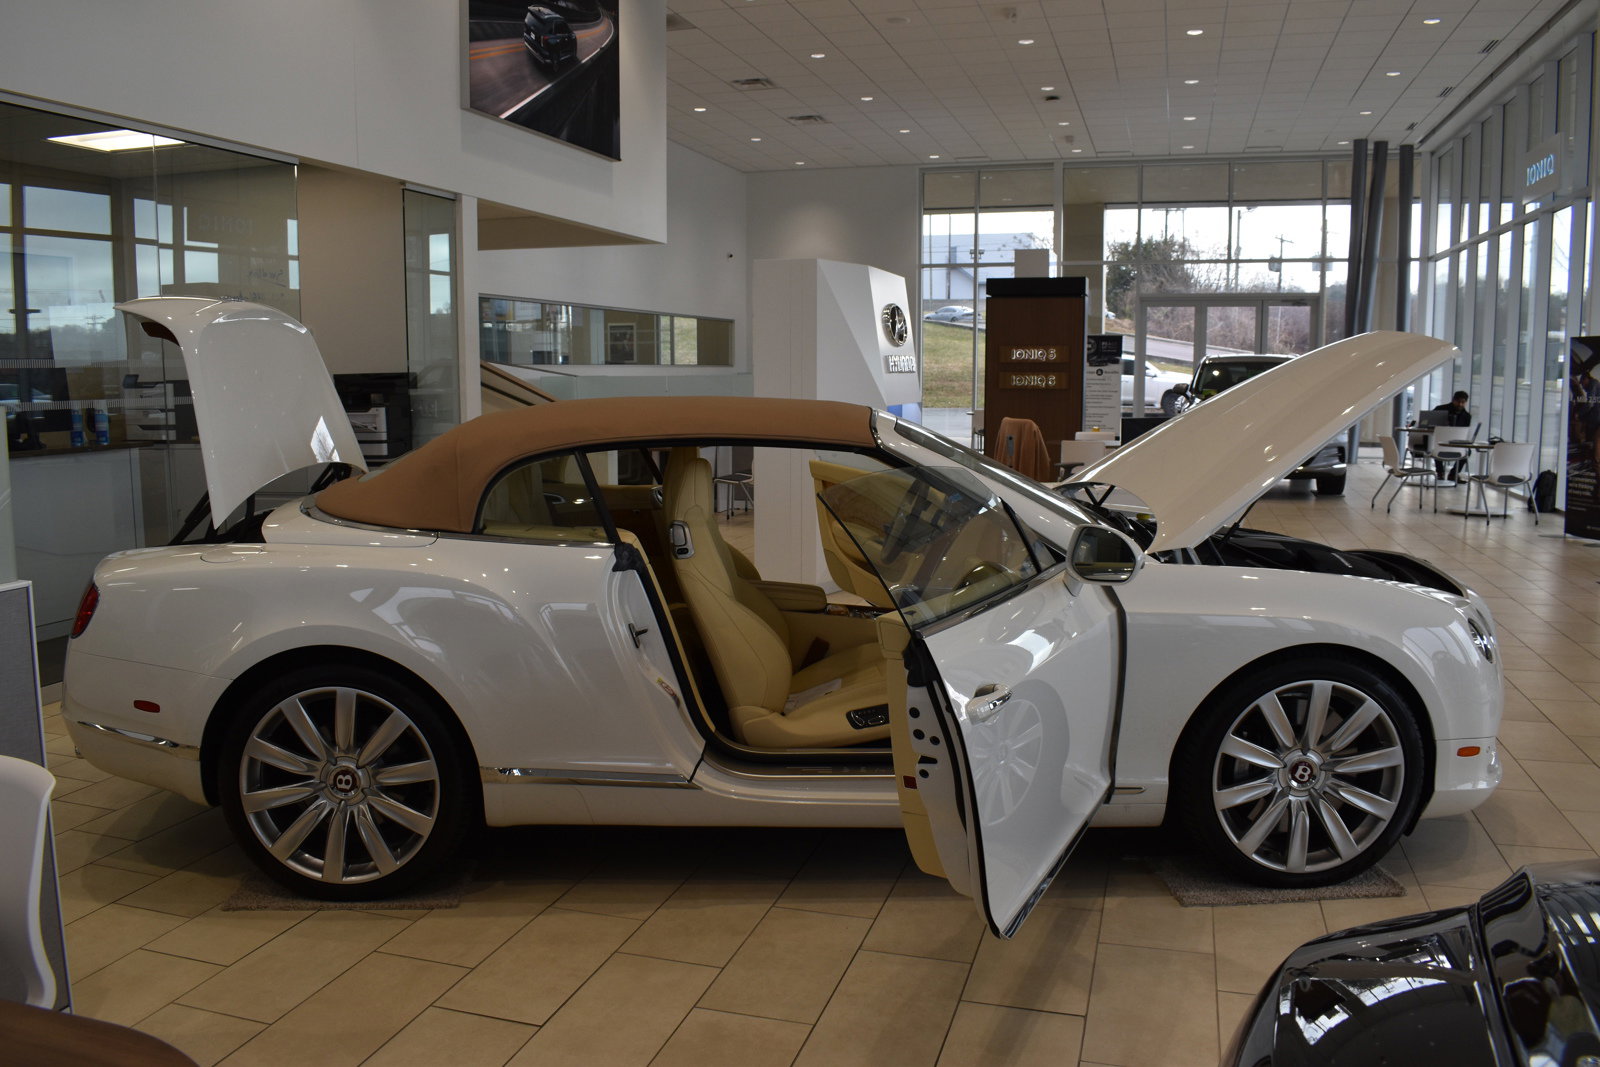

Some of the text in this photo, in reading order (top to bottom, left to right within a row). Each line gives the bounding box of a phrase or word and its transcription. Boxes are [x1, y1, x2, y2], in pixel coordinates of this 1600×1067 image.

[1526, 154, 1554, 187] IONIQ
[1011, 348, 1047, 361] IONIQ
[1011, 375, 1046, 388] IONIQ
